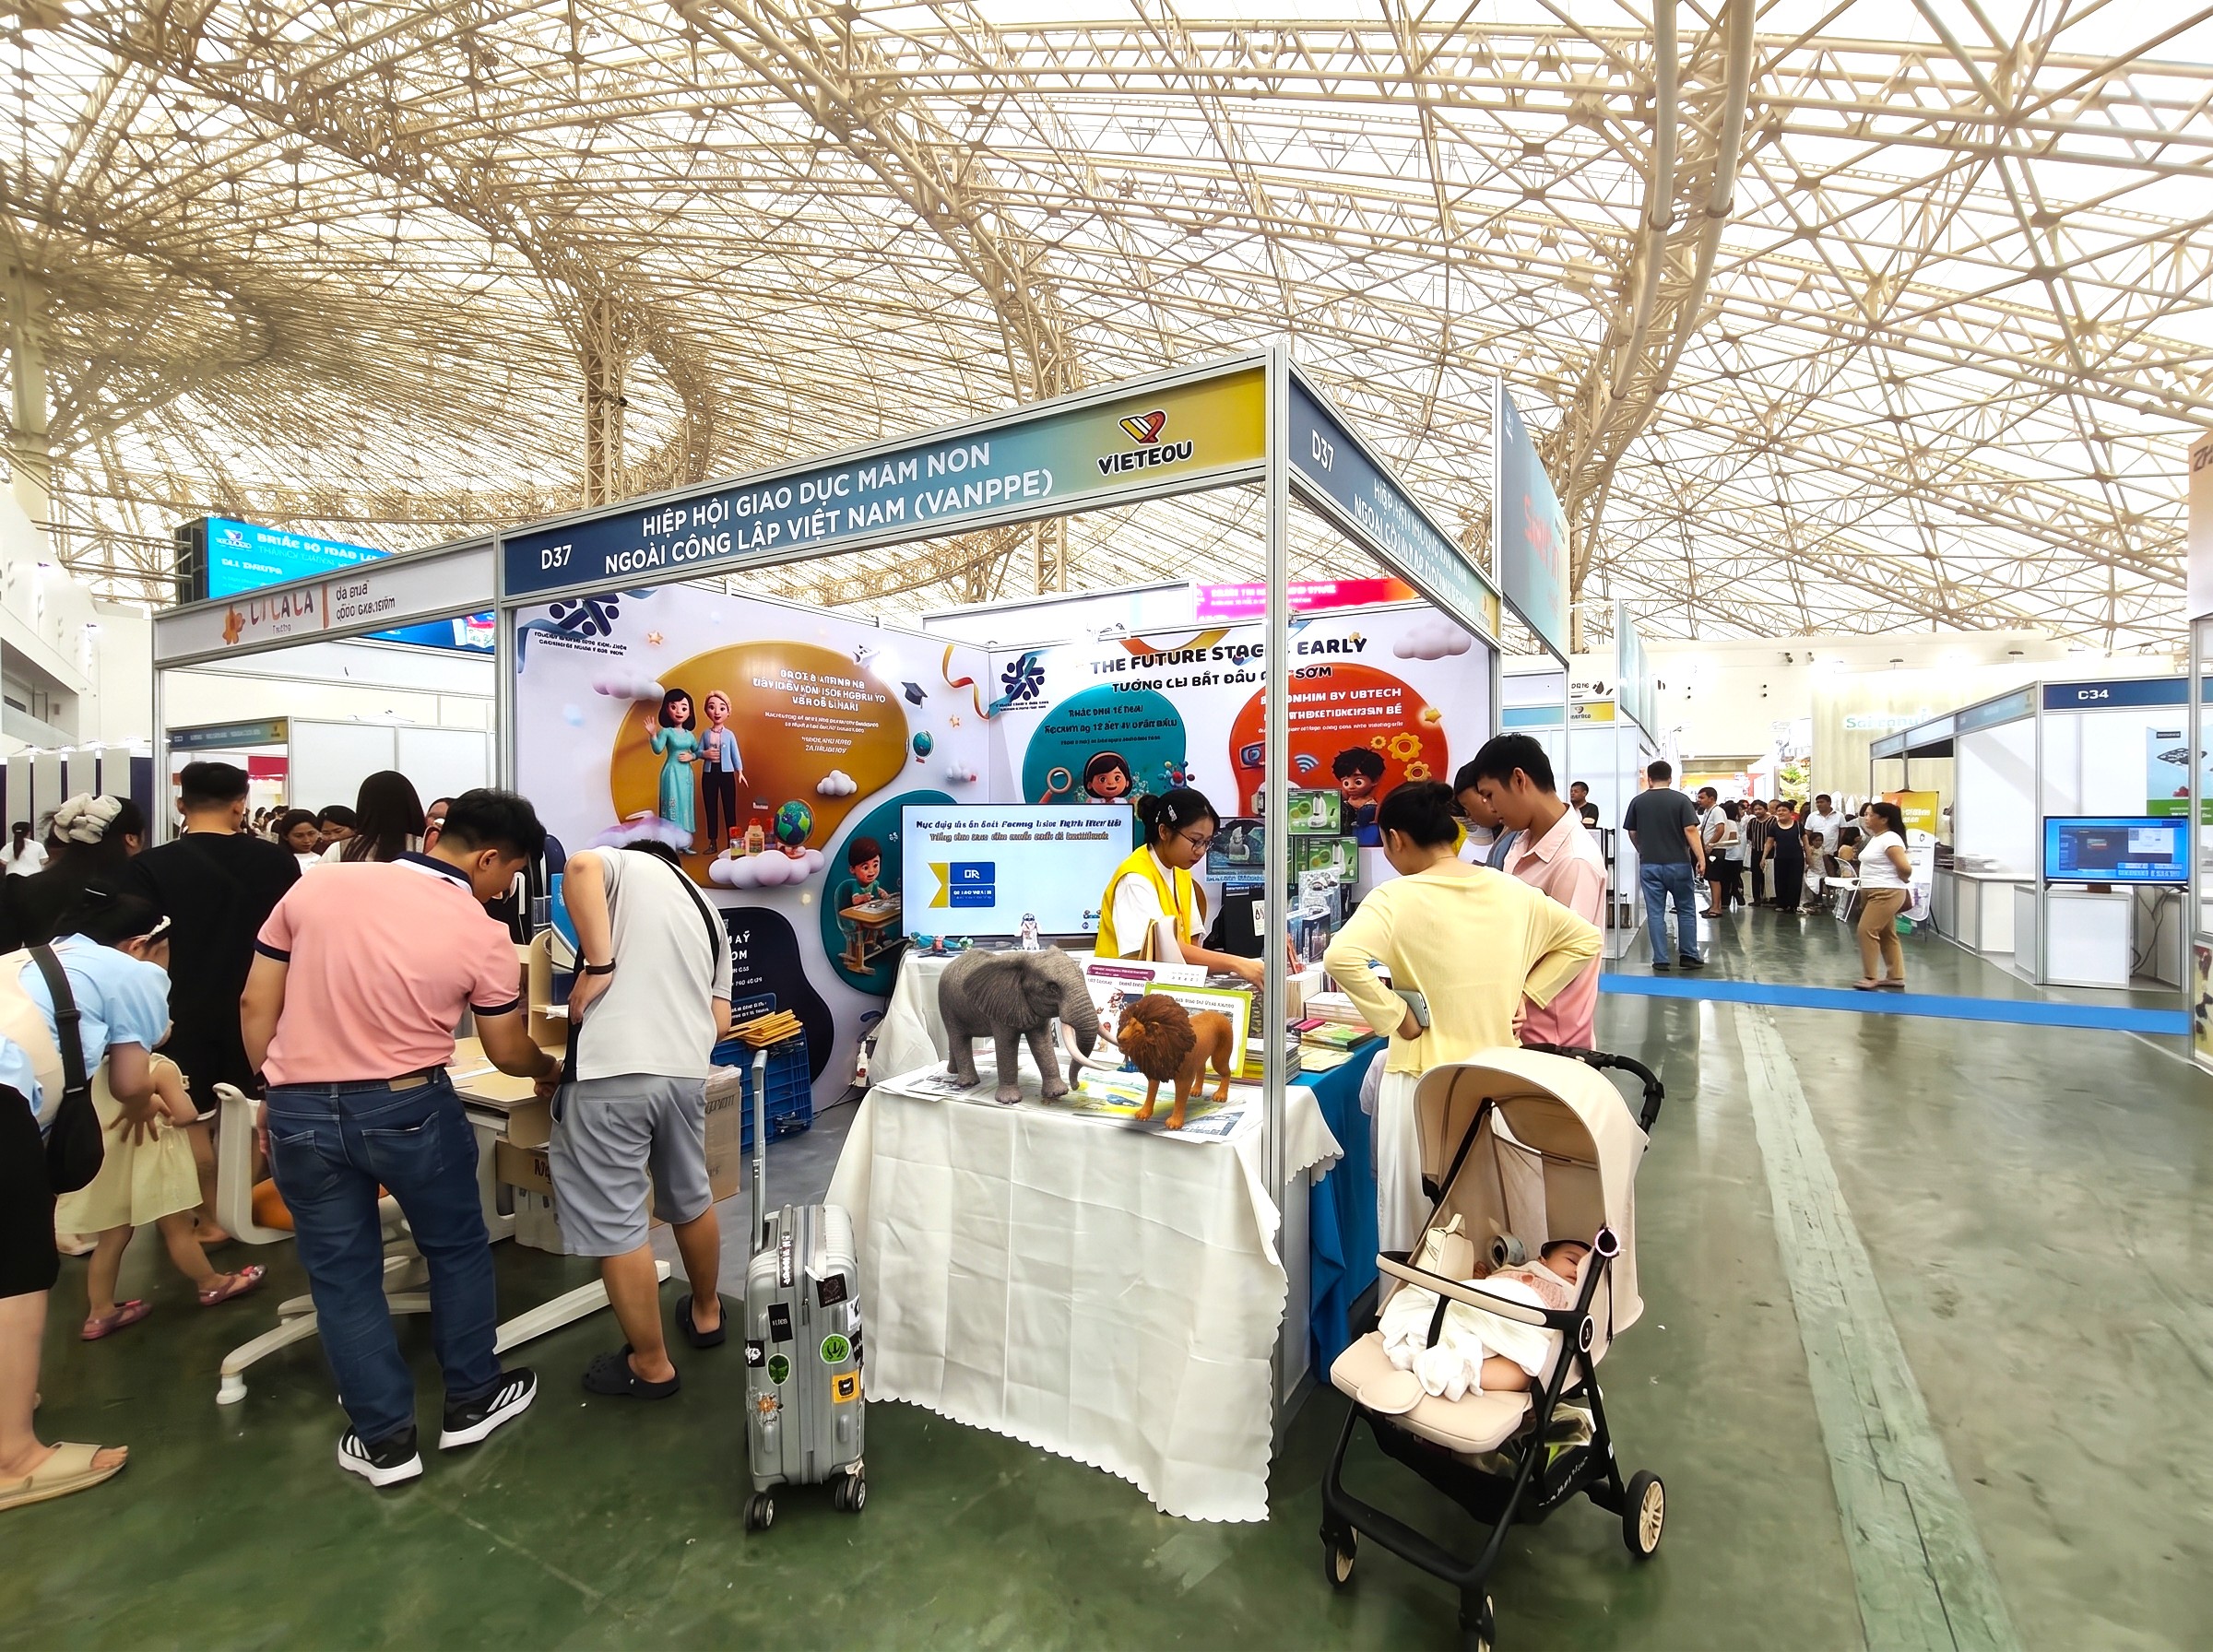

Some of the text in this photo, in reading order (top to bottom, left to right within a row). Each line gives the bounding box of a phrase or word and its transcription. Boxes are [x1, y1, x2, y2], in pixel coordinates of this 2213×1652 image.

[1311, 429, 1334, 473] D37
[643, 507, 687, 538] HIỆP
[692, 497, 729, 529] HỘI
[736, 487, 792, 517] GIAO
[799, 474, 850, 507] DỤC
[928, 442, 990, 478] NON
[605, 468, 1054, 574] NGOÀI CÔNG LẬP VIỆT NAM (VANPPE)
[541, 544, 572, 570] D37
[1091, 658, 1126, 674] THE
[1130, 649, 1207, 668] FUTURE
[1297, 637, 1367, 655] EARLY
[1350, 688, 1402, 700] UBTECH
